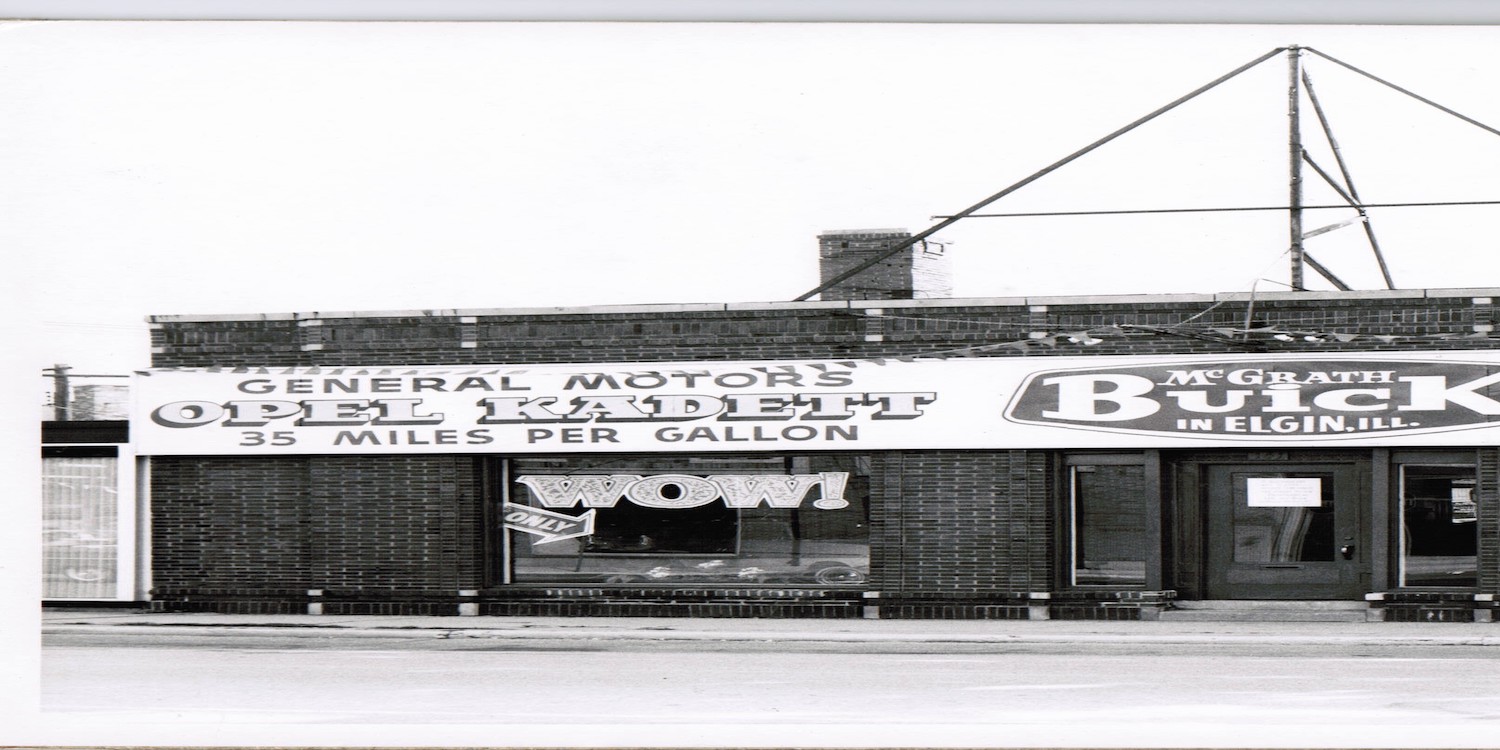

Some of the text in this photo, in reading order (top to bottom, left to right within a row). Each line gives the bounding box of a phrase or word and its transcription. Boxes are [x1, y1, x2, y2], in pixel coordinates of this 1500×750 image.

[238, 371, 854, 395] GENERAL MOTORS
[1157, 368, 1397, 386] McGRATH
[150, 391, 937, 428] OPEL KADETT
[239, 424, 859, 447] 35 MILES PER GALLON
[1177, 418, 1213, 431] IN
[515, 471, 850, 510] WOW!
[504, 511, 577, 533] ONLY
